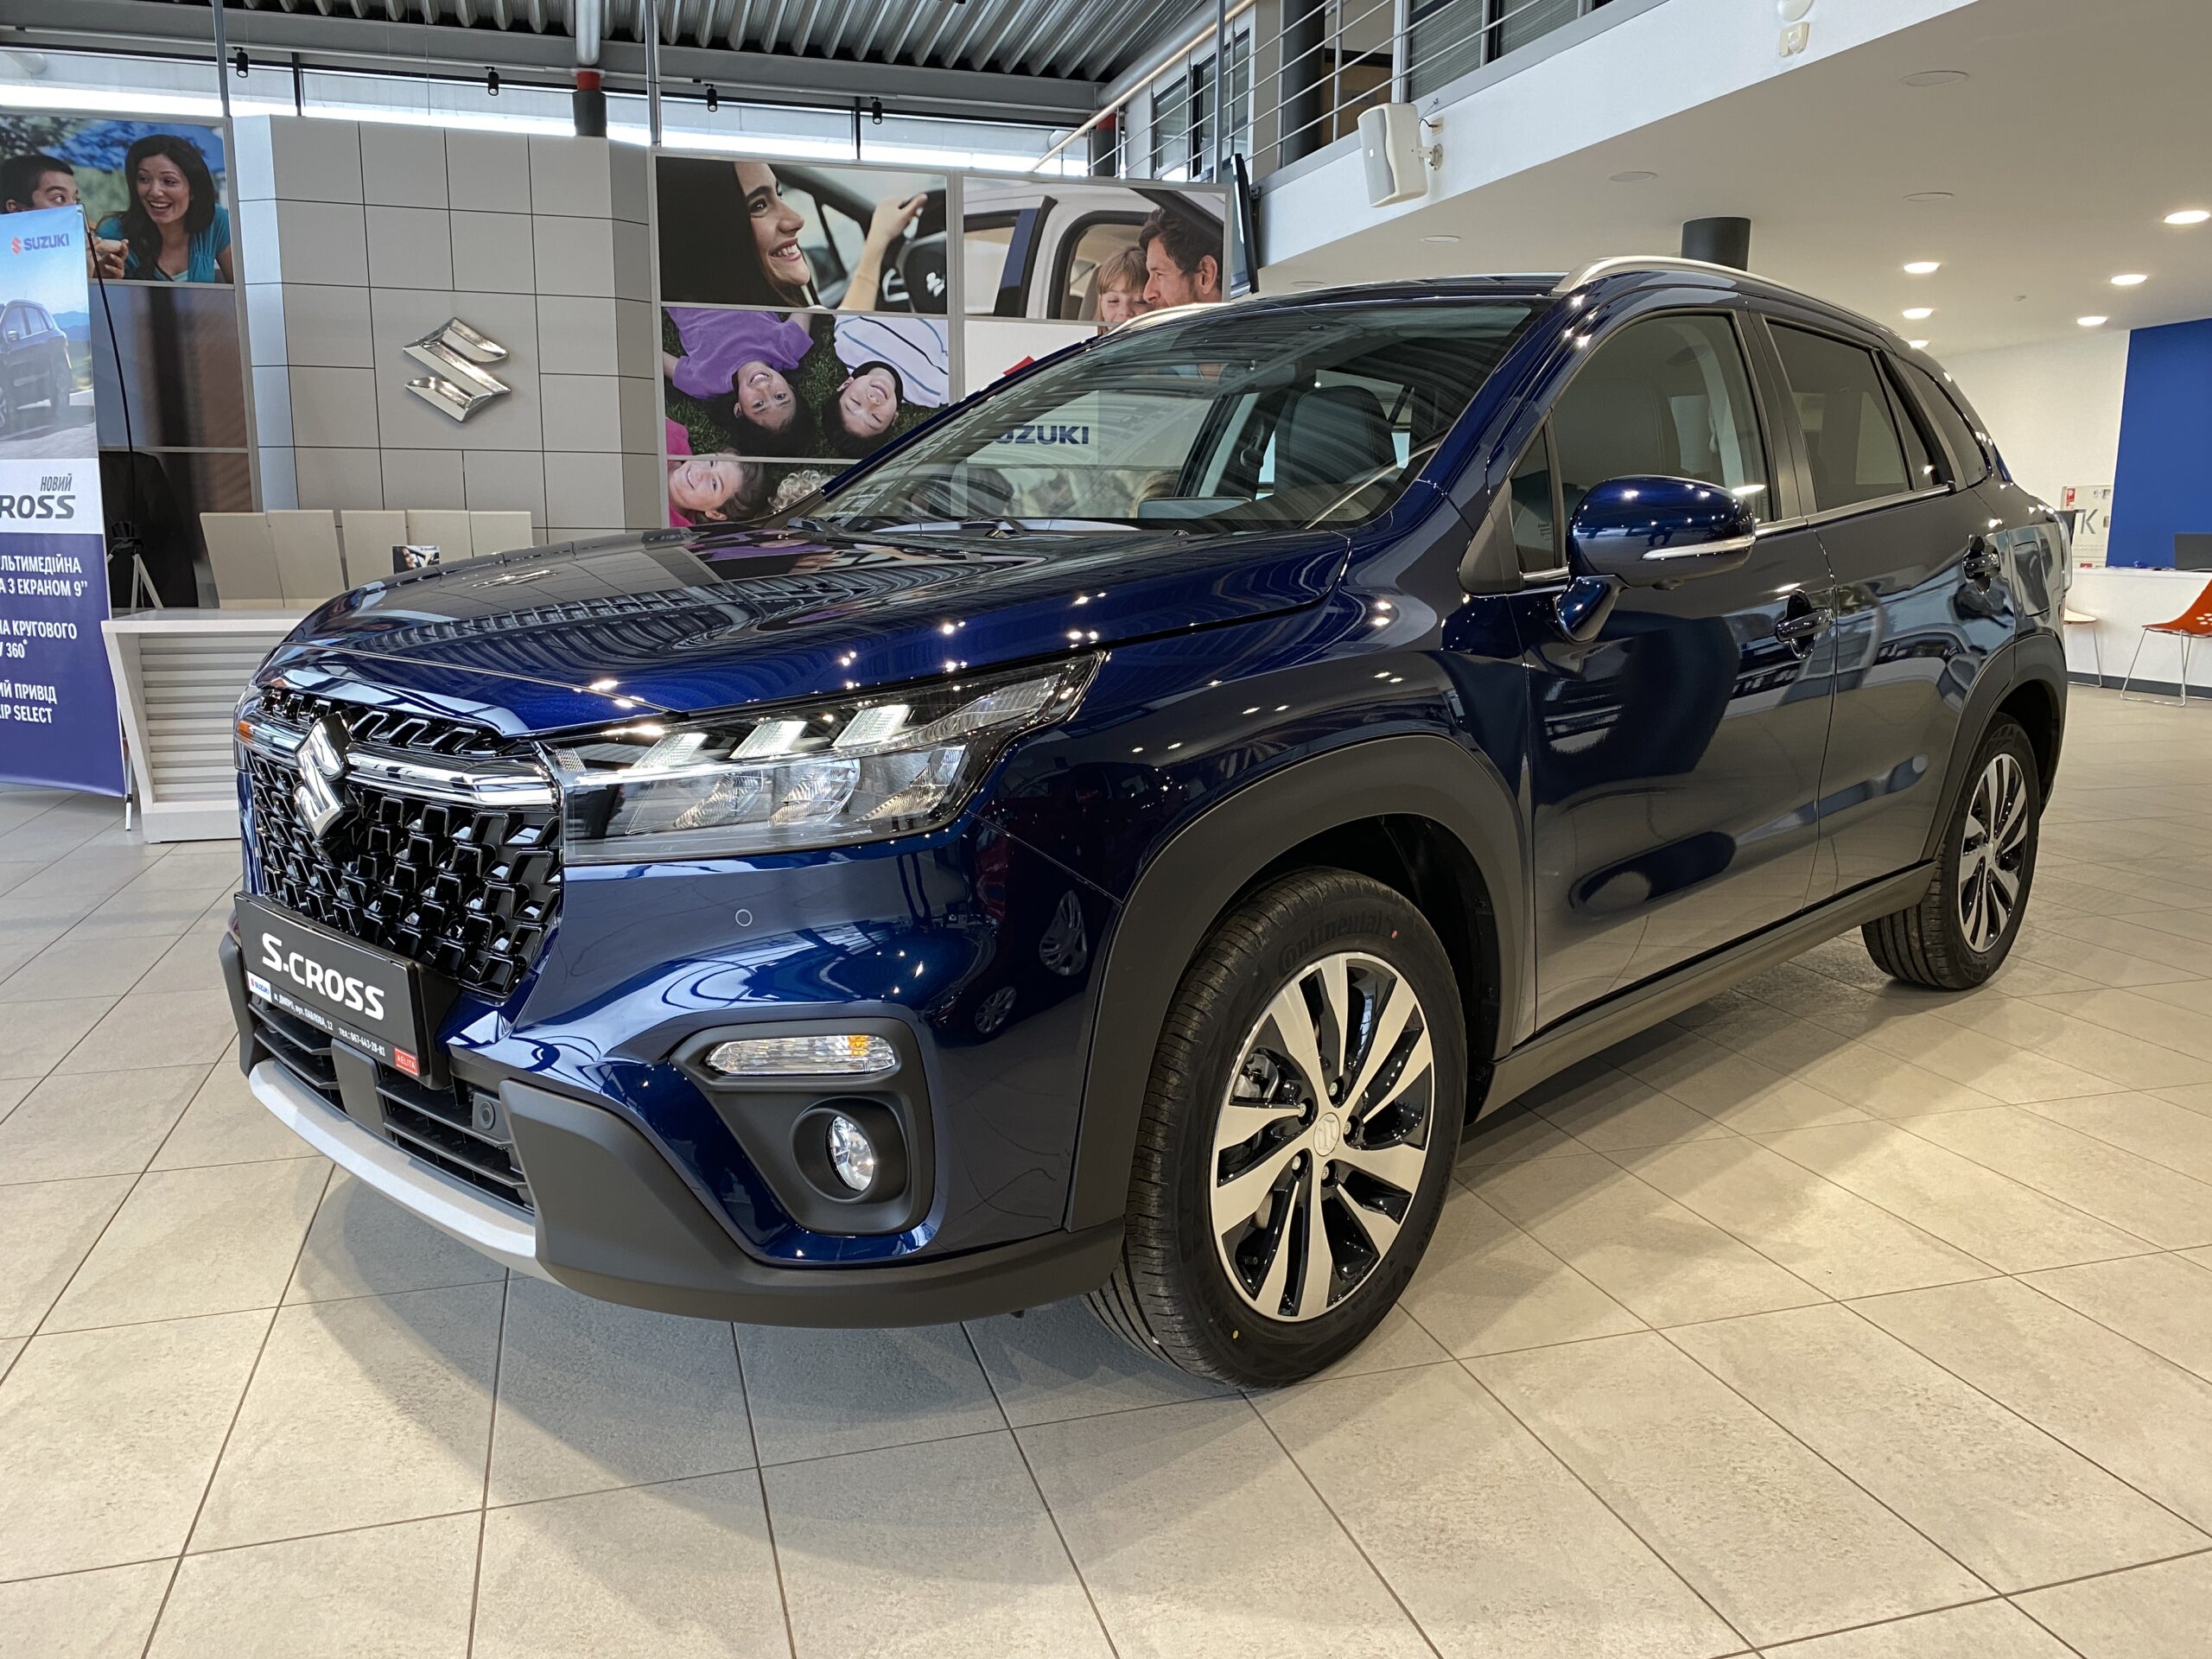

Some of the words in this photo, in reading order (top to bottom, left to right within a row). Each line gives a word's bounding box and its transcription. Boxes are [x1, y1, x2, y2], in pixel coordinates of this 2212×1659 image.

[23, 233, 70, 251] SUZUKI
[995, 425, 1089, 444] UZUKI
[40, 473, 73, 492] НОВИЙ
[0, 494, 76, 519] ROSS
[0, 554, 82, 575] ЛЬТИМЕДІЙНА
[17, 578, 71, 597] ЕКРАНОМ
[12, 620, 78, 639] КРУГОВОГО
[14, 683, 58, 704] ПРИВІД
[14, 705, 53, 723] SELECT
[397, 1054, 416, 1070] AELITA
